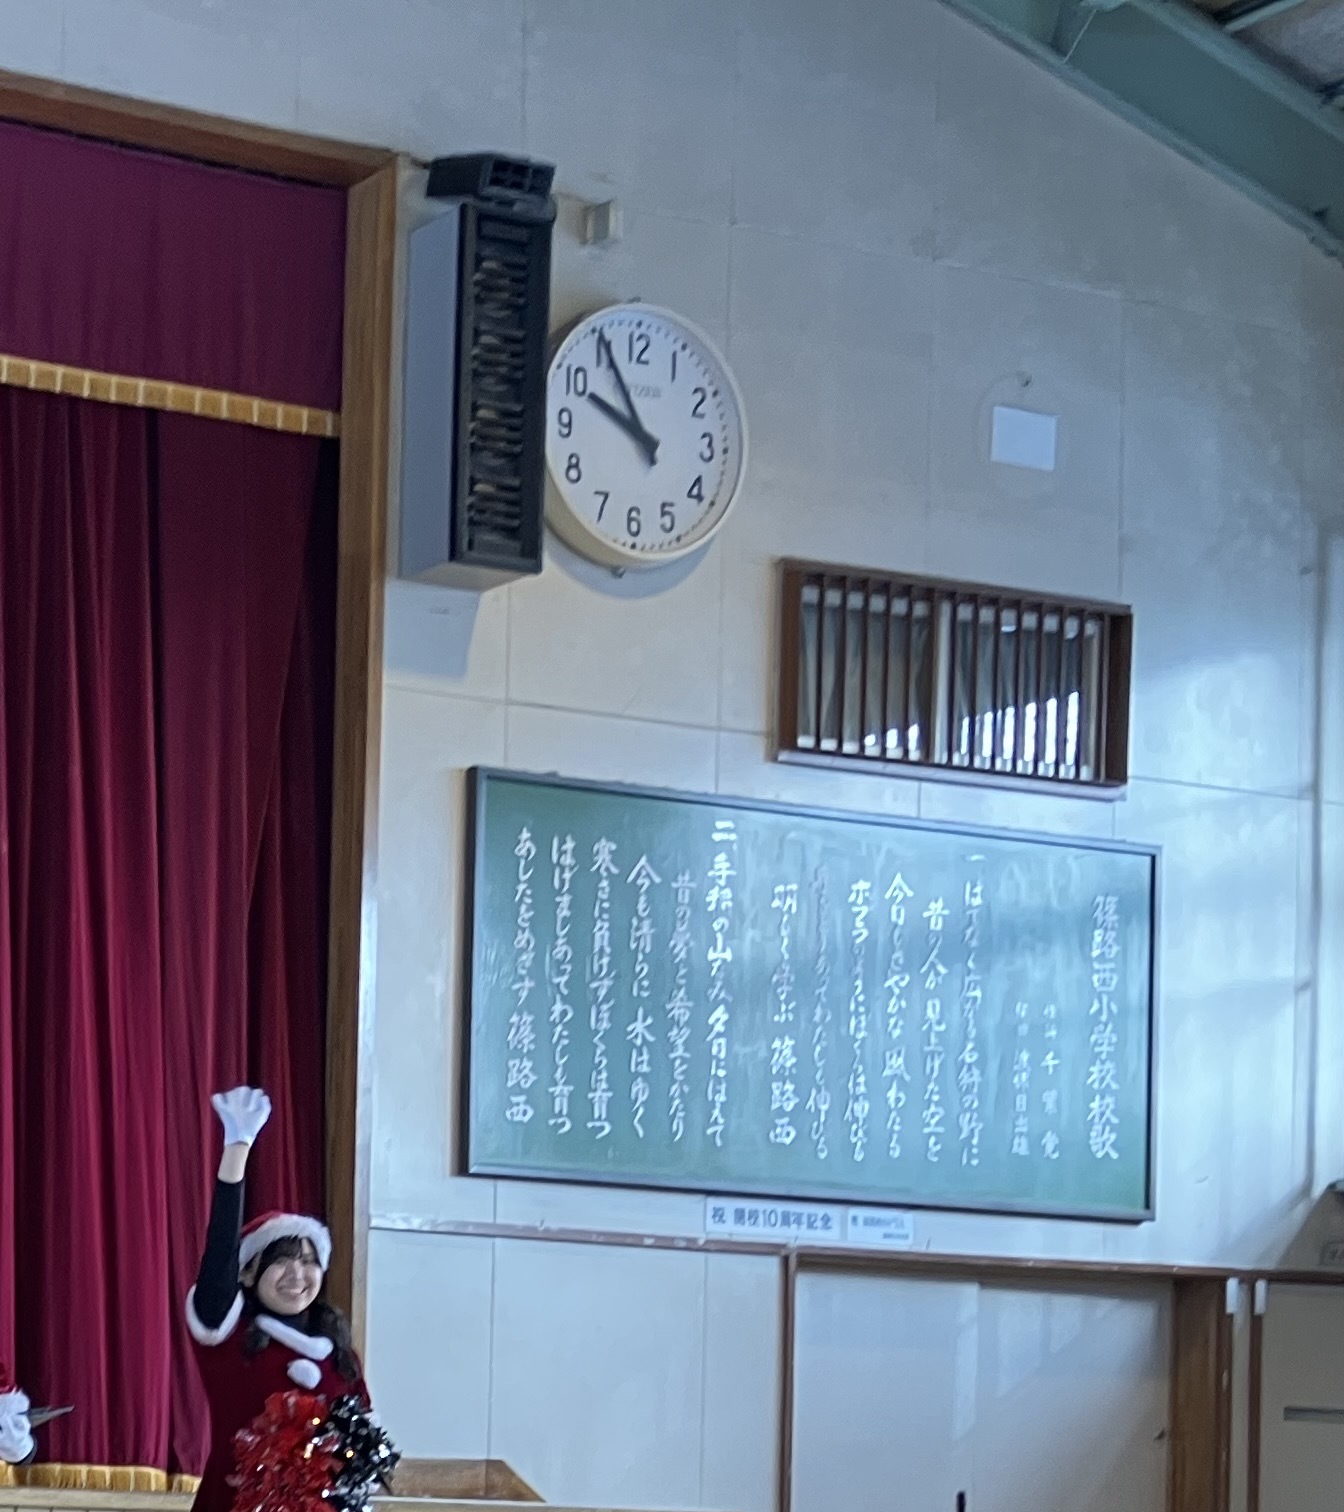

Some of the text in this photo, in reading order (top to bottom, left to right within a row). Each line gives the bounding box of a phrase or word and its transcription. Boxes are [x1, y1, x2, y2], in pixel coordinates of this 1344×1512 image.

[628, 331, 650, 365] 12
[565, 366, 587, 397] 10
[692, 387, 707, 418] 2
[558, 408, 572, 438] 9
[699, 433, 714, 463] 3
[565, 454, 581, 484] 8
[687, 475, 704, 505] 4
[593, 491, 610, 523] 7
[627, 506, 641, 536] 6
[660, 502, 675, 533] 5
